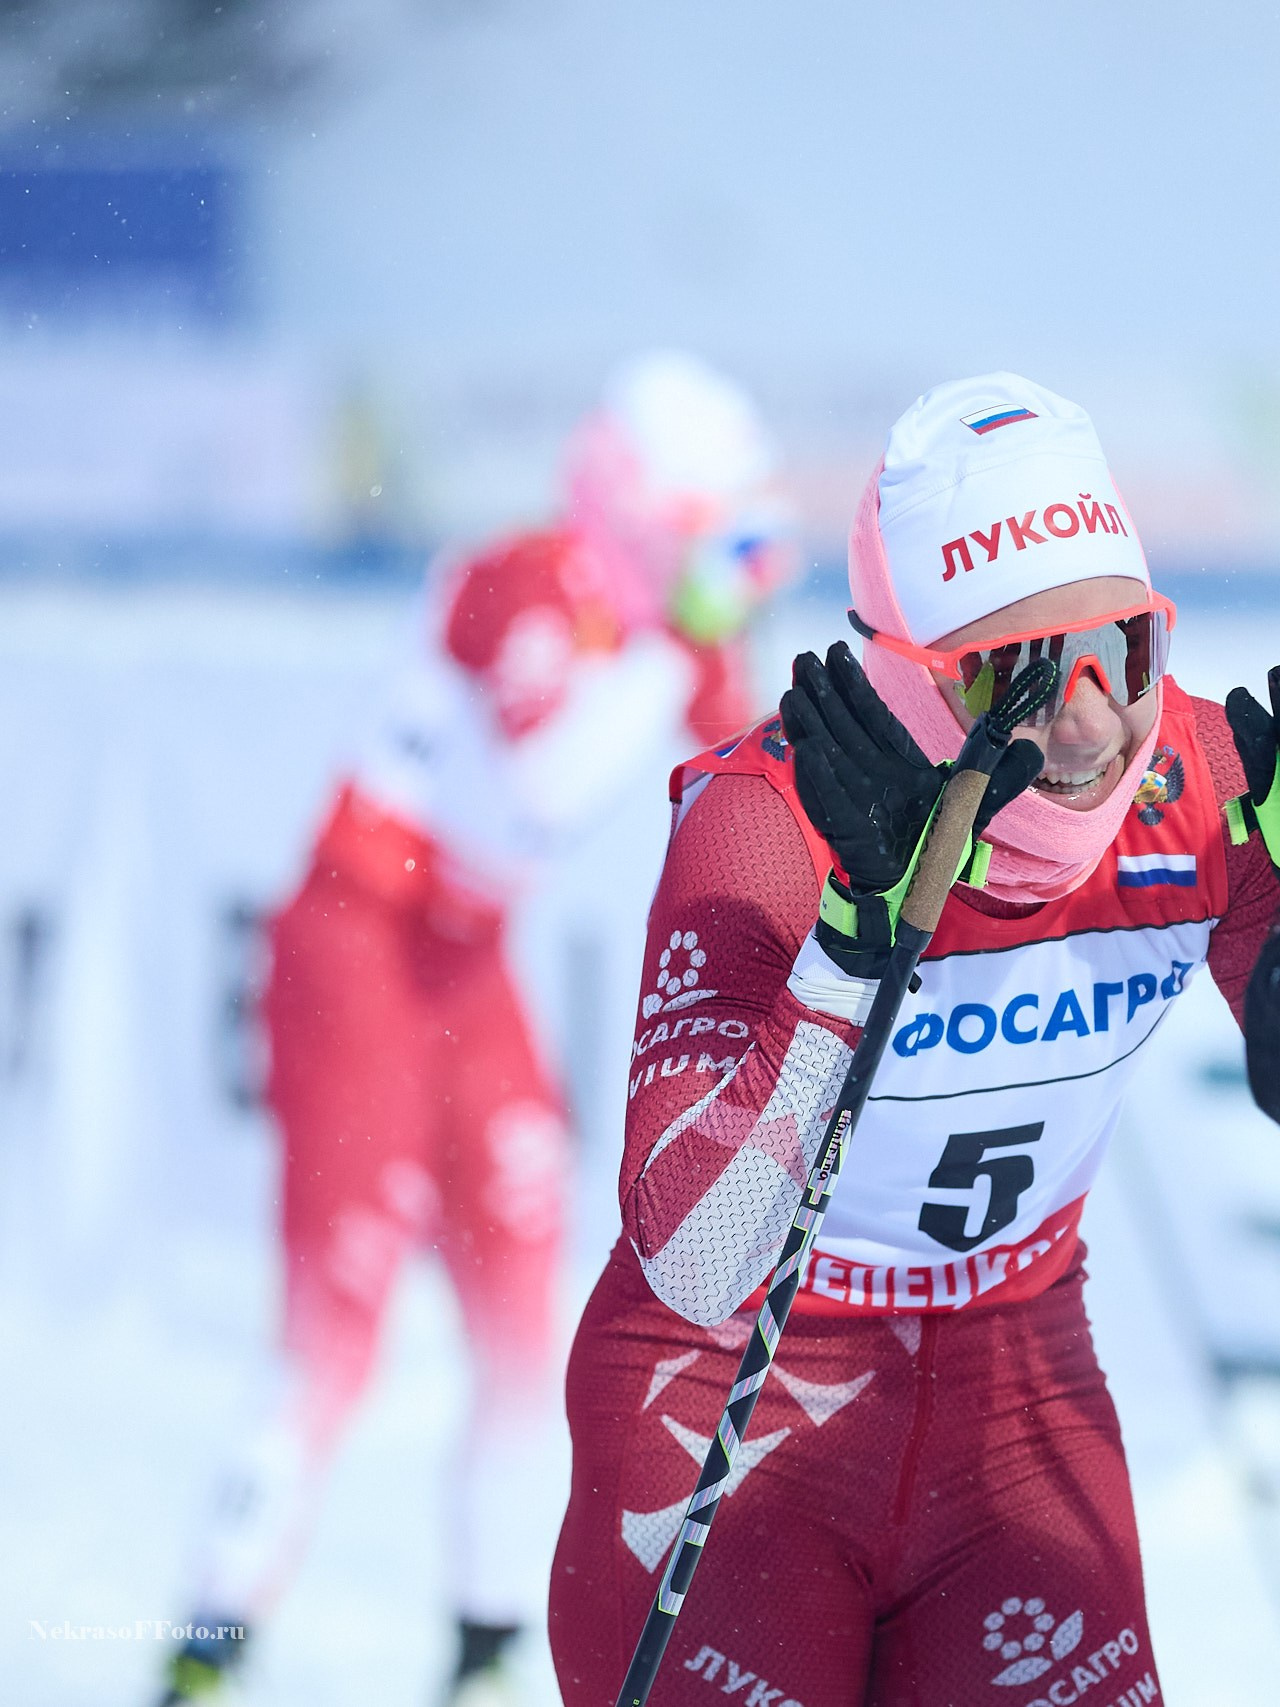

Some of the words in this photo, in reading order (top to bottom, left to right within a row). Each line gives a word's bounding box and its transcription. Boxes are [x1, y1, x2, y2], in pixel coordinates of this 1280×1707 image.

[942, 493, 1128, 582] ЛУКОЙЛ
[630, 1017, 749, 1065] САГРО
[892, 960, 1194, 1058] ФОСАГРО
[918, 1121, 1045, 1252] 5
[684, 1645, 804, 1707] ЛУК
[1024, 1628, 1139, 1707] САГРО
